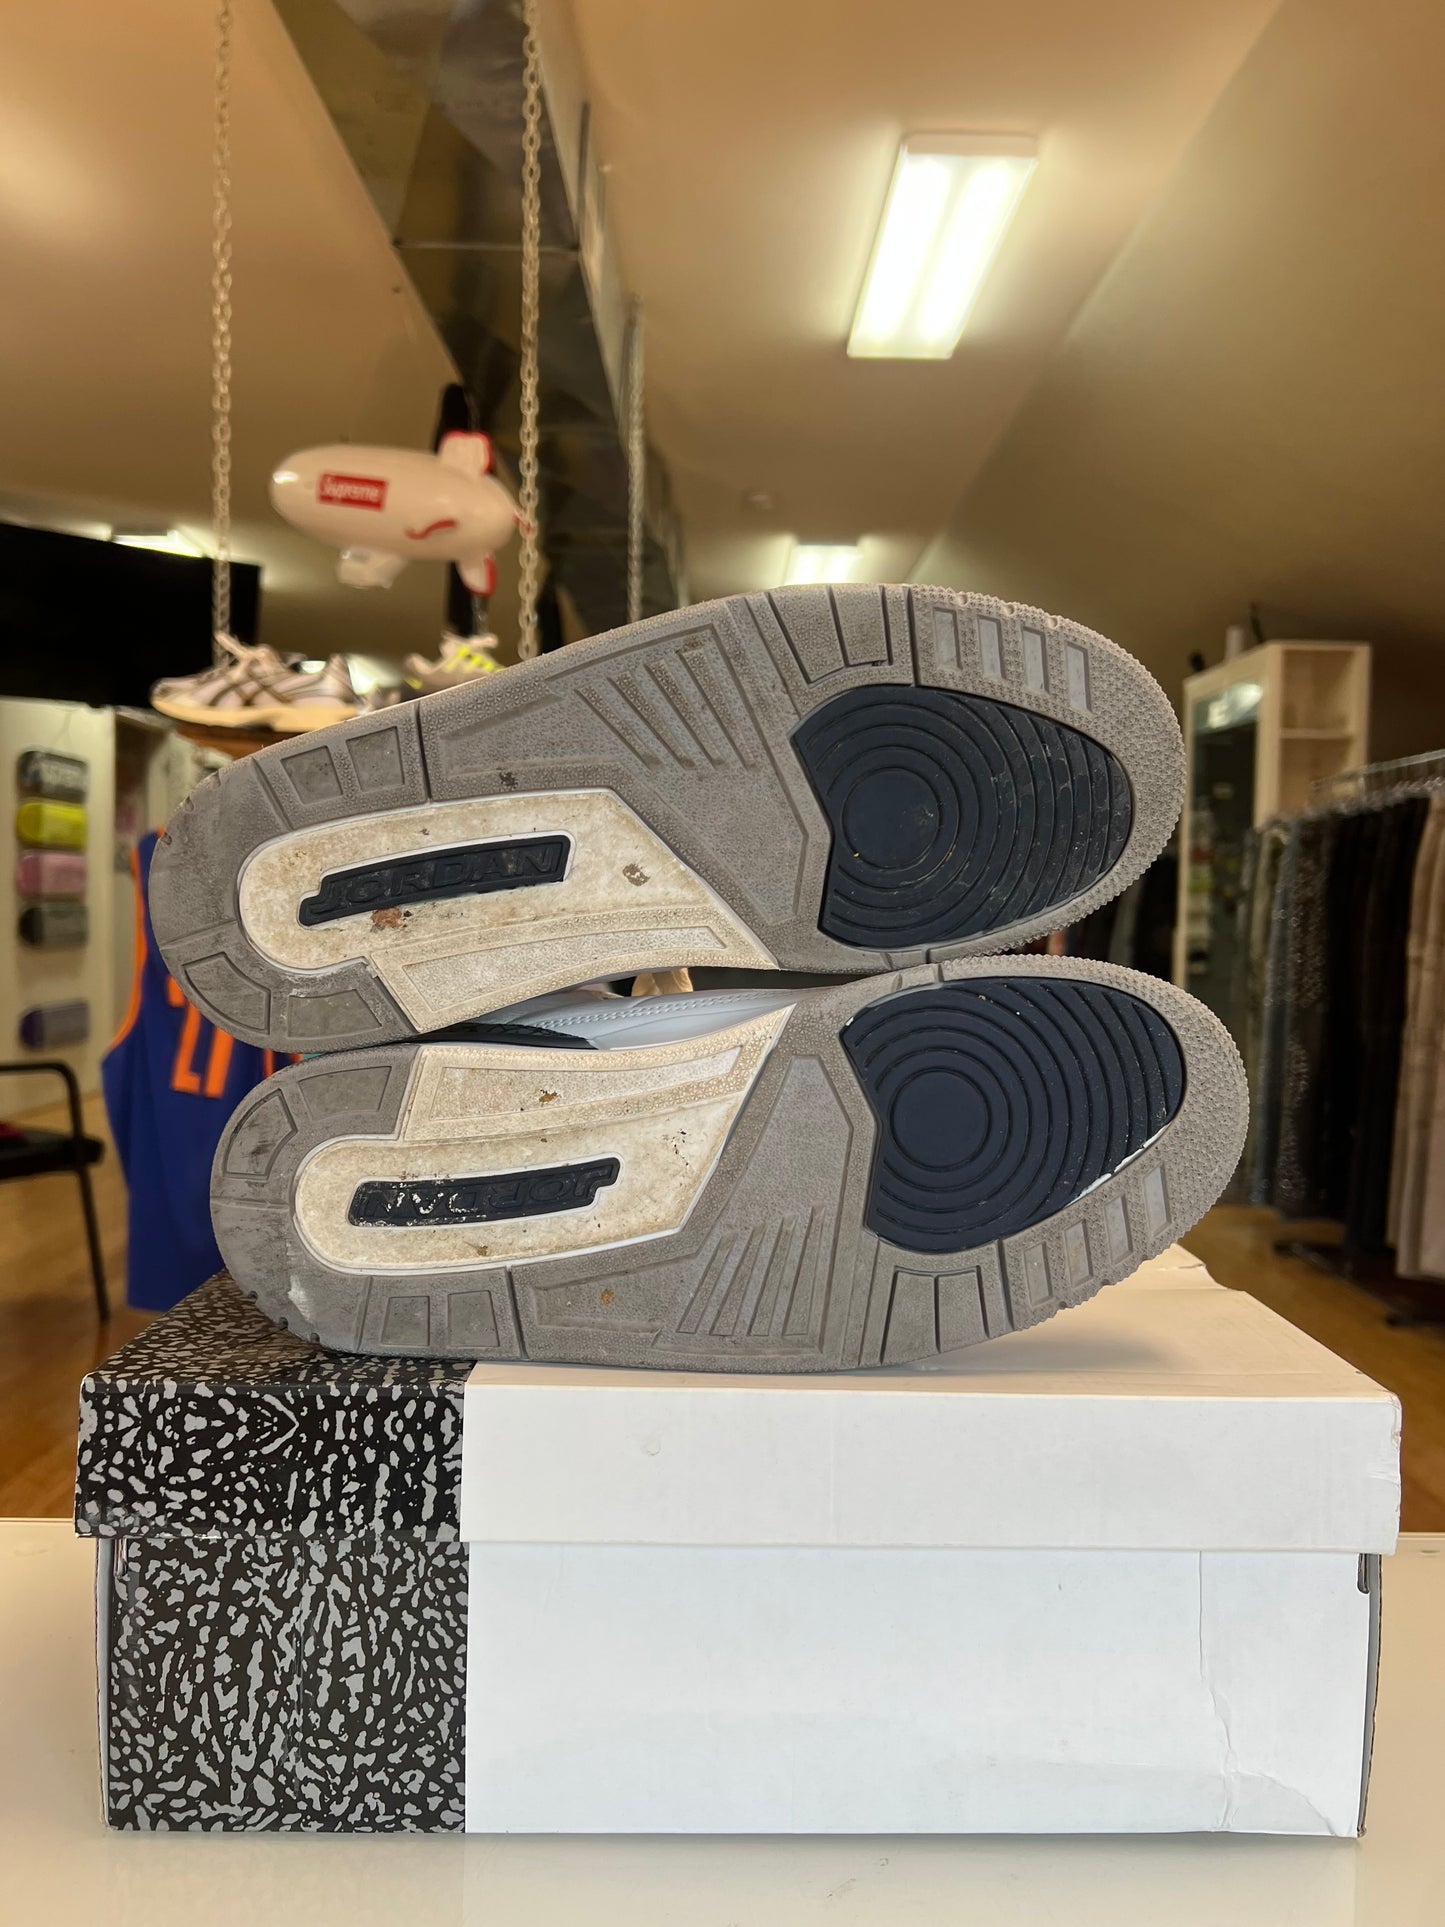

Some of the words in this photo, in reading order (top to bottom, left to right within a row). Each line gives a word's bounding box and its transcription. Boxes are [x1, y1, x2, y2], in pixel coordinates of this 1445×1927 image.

[322, 477, 381, 502] Supreme
[309, 846, 556, 914] JORDAN
[360, 1166, 612, 1218] JORDAN
